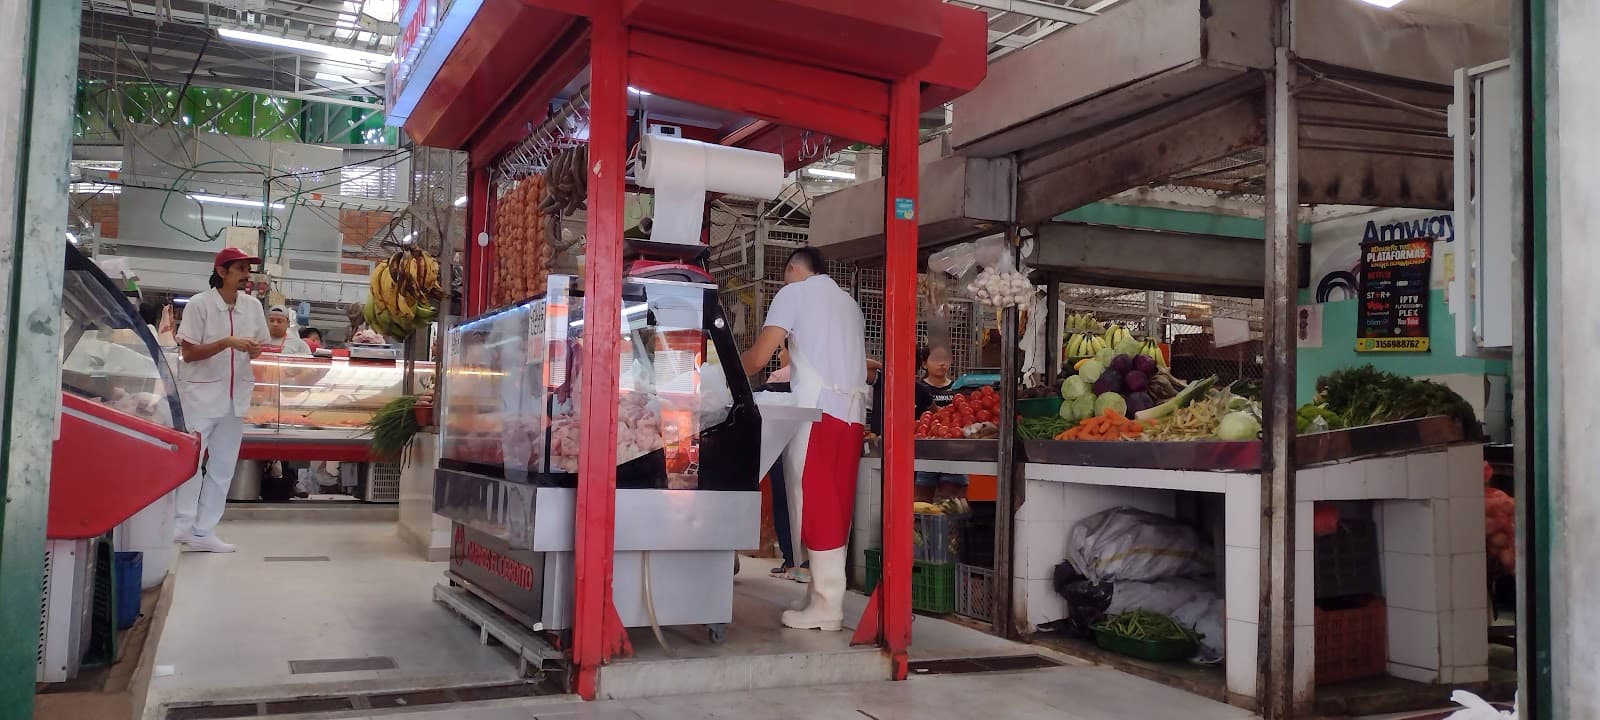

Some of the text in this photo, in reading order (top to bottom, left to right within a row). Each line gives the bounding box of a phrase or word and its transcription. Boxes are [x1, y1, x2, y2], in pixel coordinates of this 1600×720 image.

[1363, 214, 1454, 242] Amway
[1367, 248, 1425, 262] PLATAFORMAS
[1399, 295, 1419, 304] IPTV
[1398, 309, 1419, 317] PLEX
[500, 556, 534, 591] CERDITO
